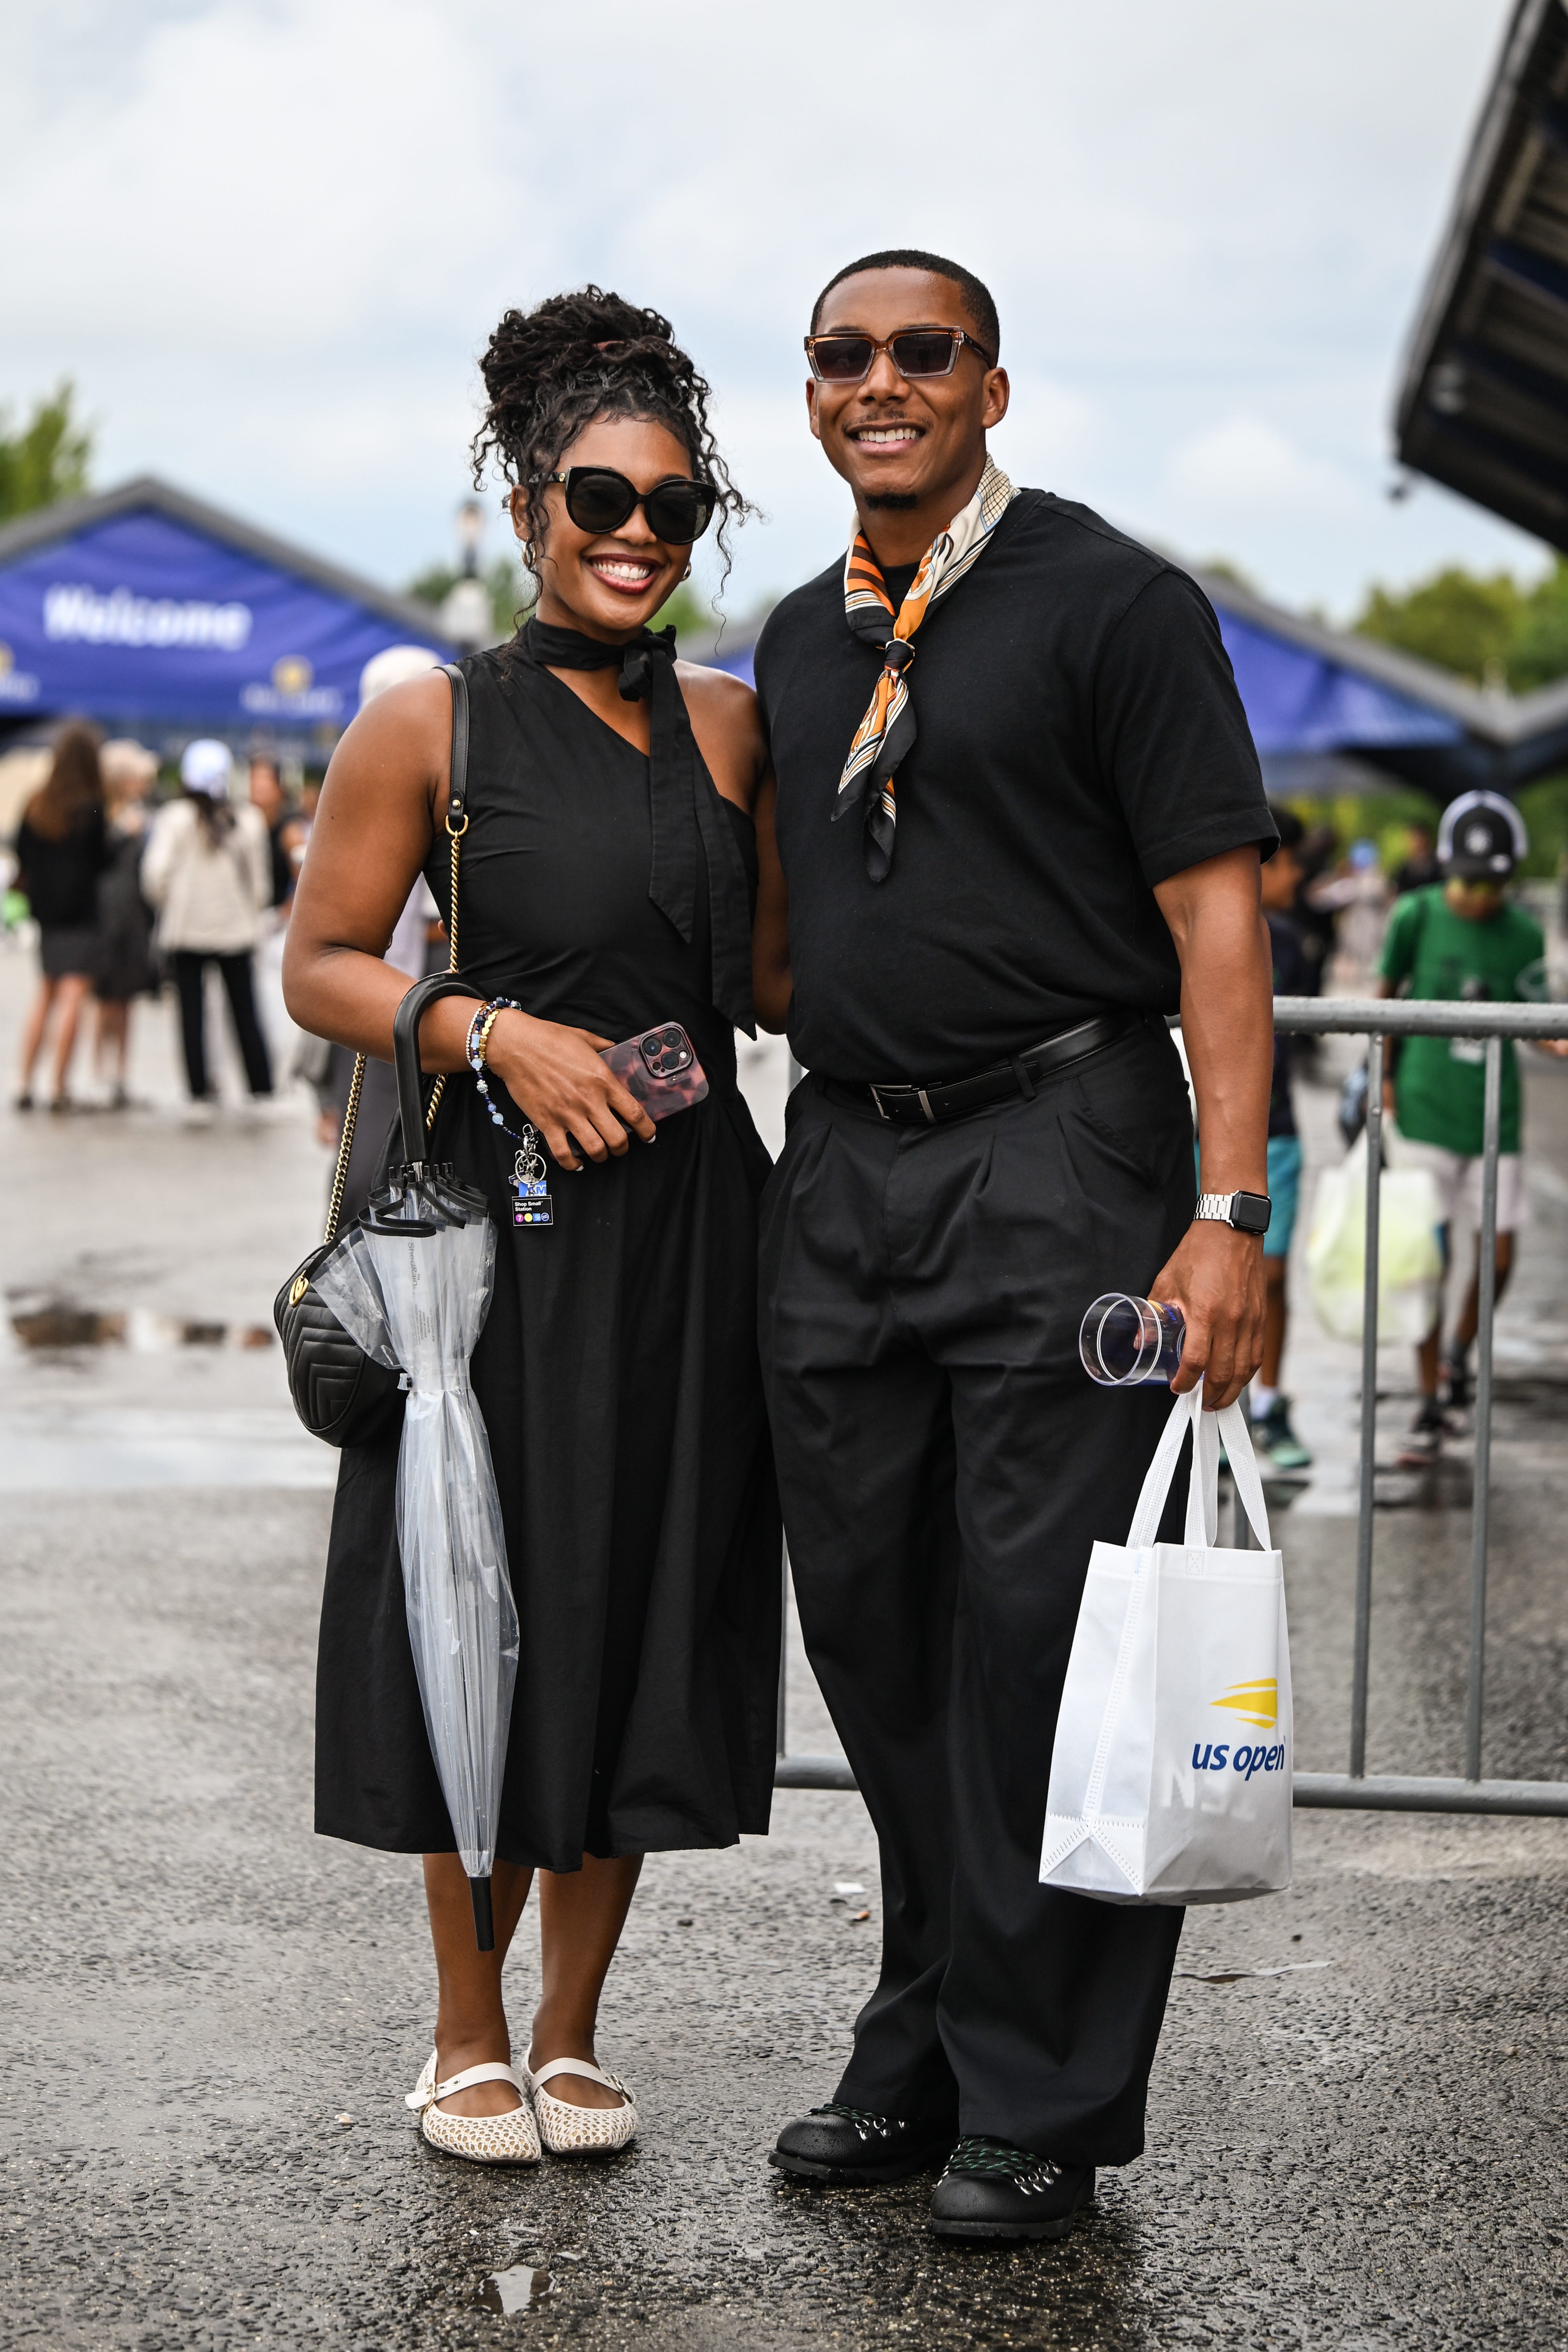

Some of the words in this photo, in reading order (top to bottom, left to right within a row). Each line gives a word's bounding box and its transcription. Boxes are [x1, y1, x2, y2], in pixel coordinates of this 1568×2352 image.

[43, 583, 252, 651] Welcome
[408, 1242, 418, 1286] ShedRain
[1192, 1743, 1230, 1771] us
[1233, 1744, 1285, 1781] open
